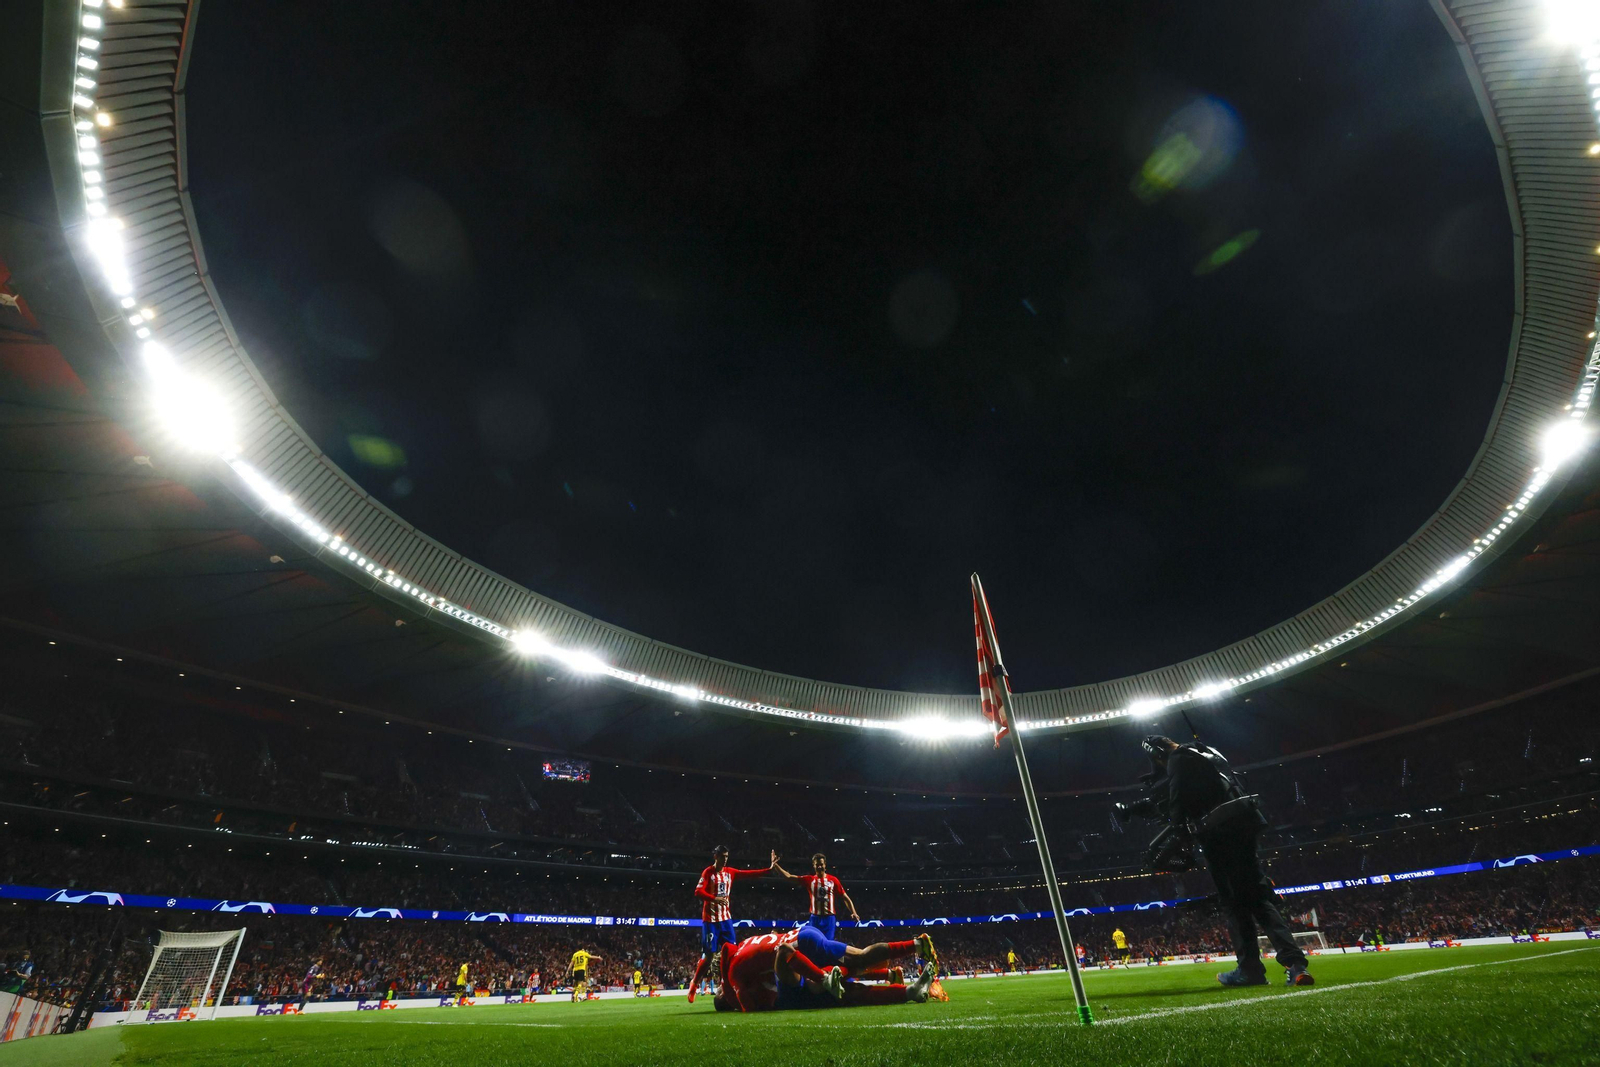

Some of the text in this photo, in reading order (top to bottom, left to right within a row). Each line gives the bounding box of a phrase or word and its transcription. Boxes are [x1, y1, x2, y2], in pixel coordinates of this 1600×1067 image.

[1345, 878, 1367, 887] 31:47
[1394, 870, 1435, 880] DORTMUND
[1427, 939, 1462, 948] FedEx
[1511, 933, 1550, 944] FedEx
[1360, 944, 1390, 952] FedEx
[576, 955, 585, 965] 15
[357, 1000, 398, 1011] FedEx
